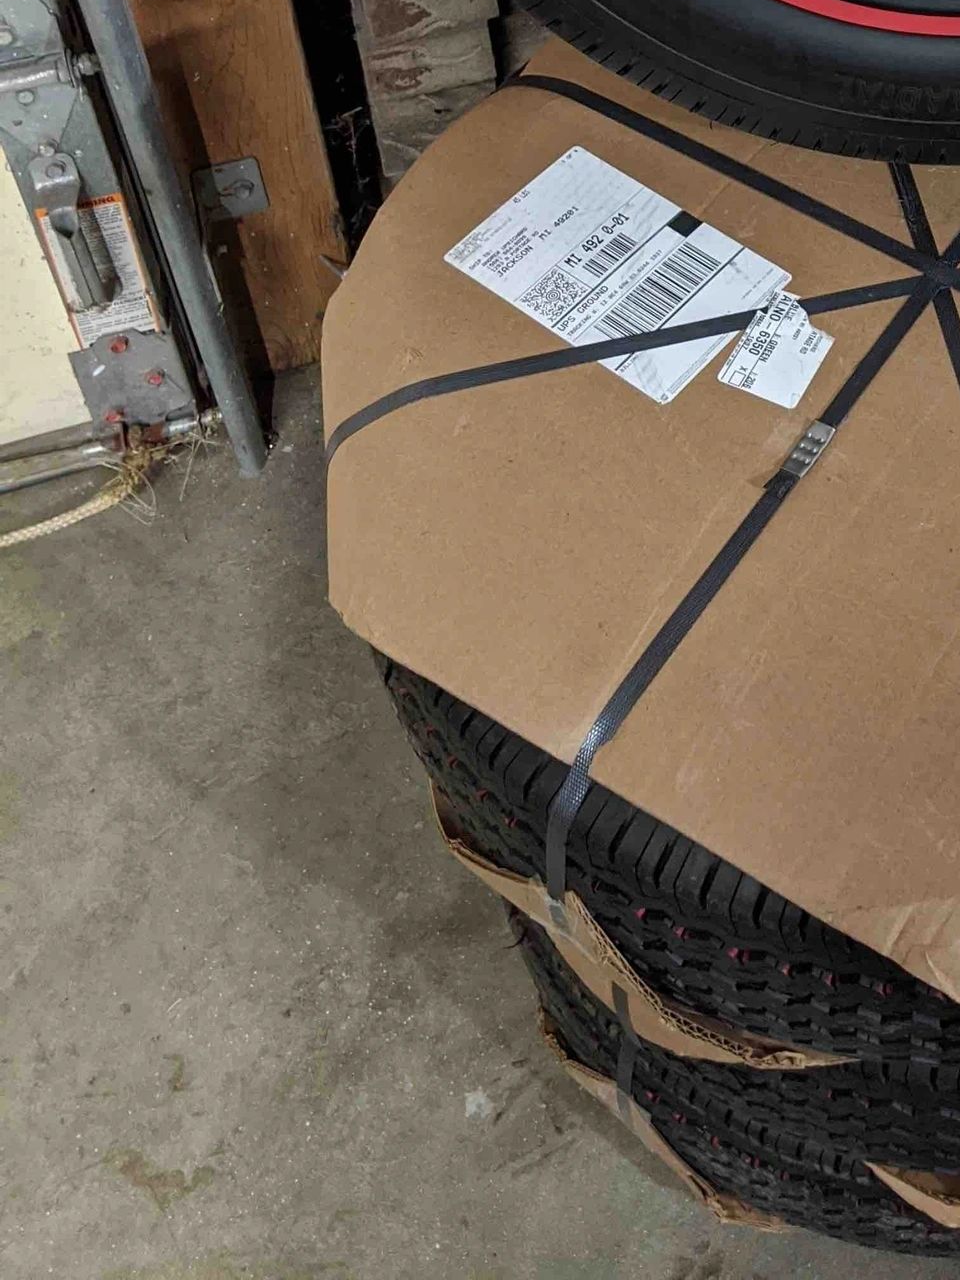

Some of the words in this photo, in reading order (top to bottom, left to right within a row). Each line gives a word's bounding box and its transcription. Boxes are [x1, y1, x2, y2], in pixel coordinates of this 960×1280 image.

[497, 245, 533, 277] JACKSON
[538, 229, 551, 240] MI
[554, 206, 579, 228] 49201
[564, 253, 582, 268] MI
[582, 234, 604, 253] 492
[557, 315, 576, 332] UPS
[577, 285, 609, 314] GROUND
[770, 294, 792, 322] ALNO
[567, 315, 592, 336] TRACKING
[748, 330, 770, 357] 6350
[759, 338, 778, 363] GREEN
